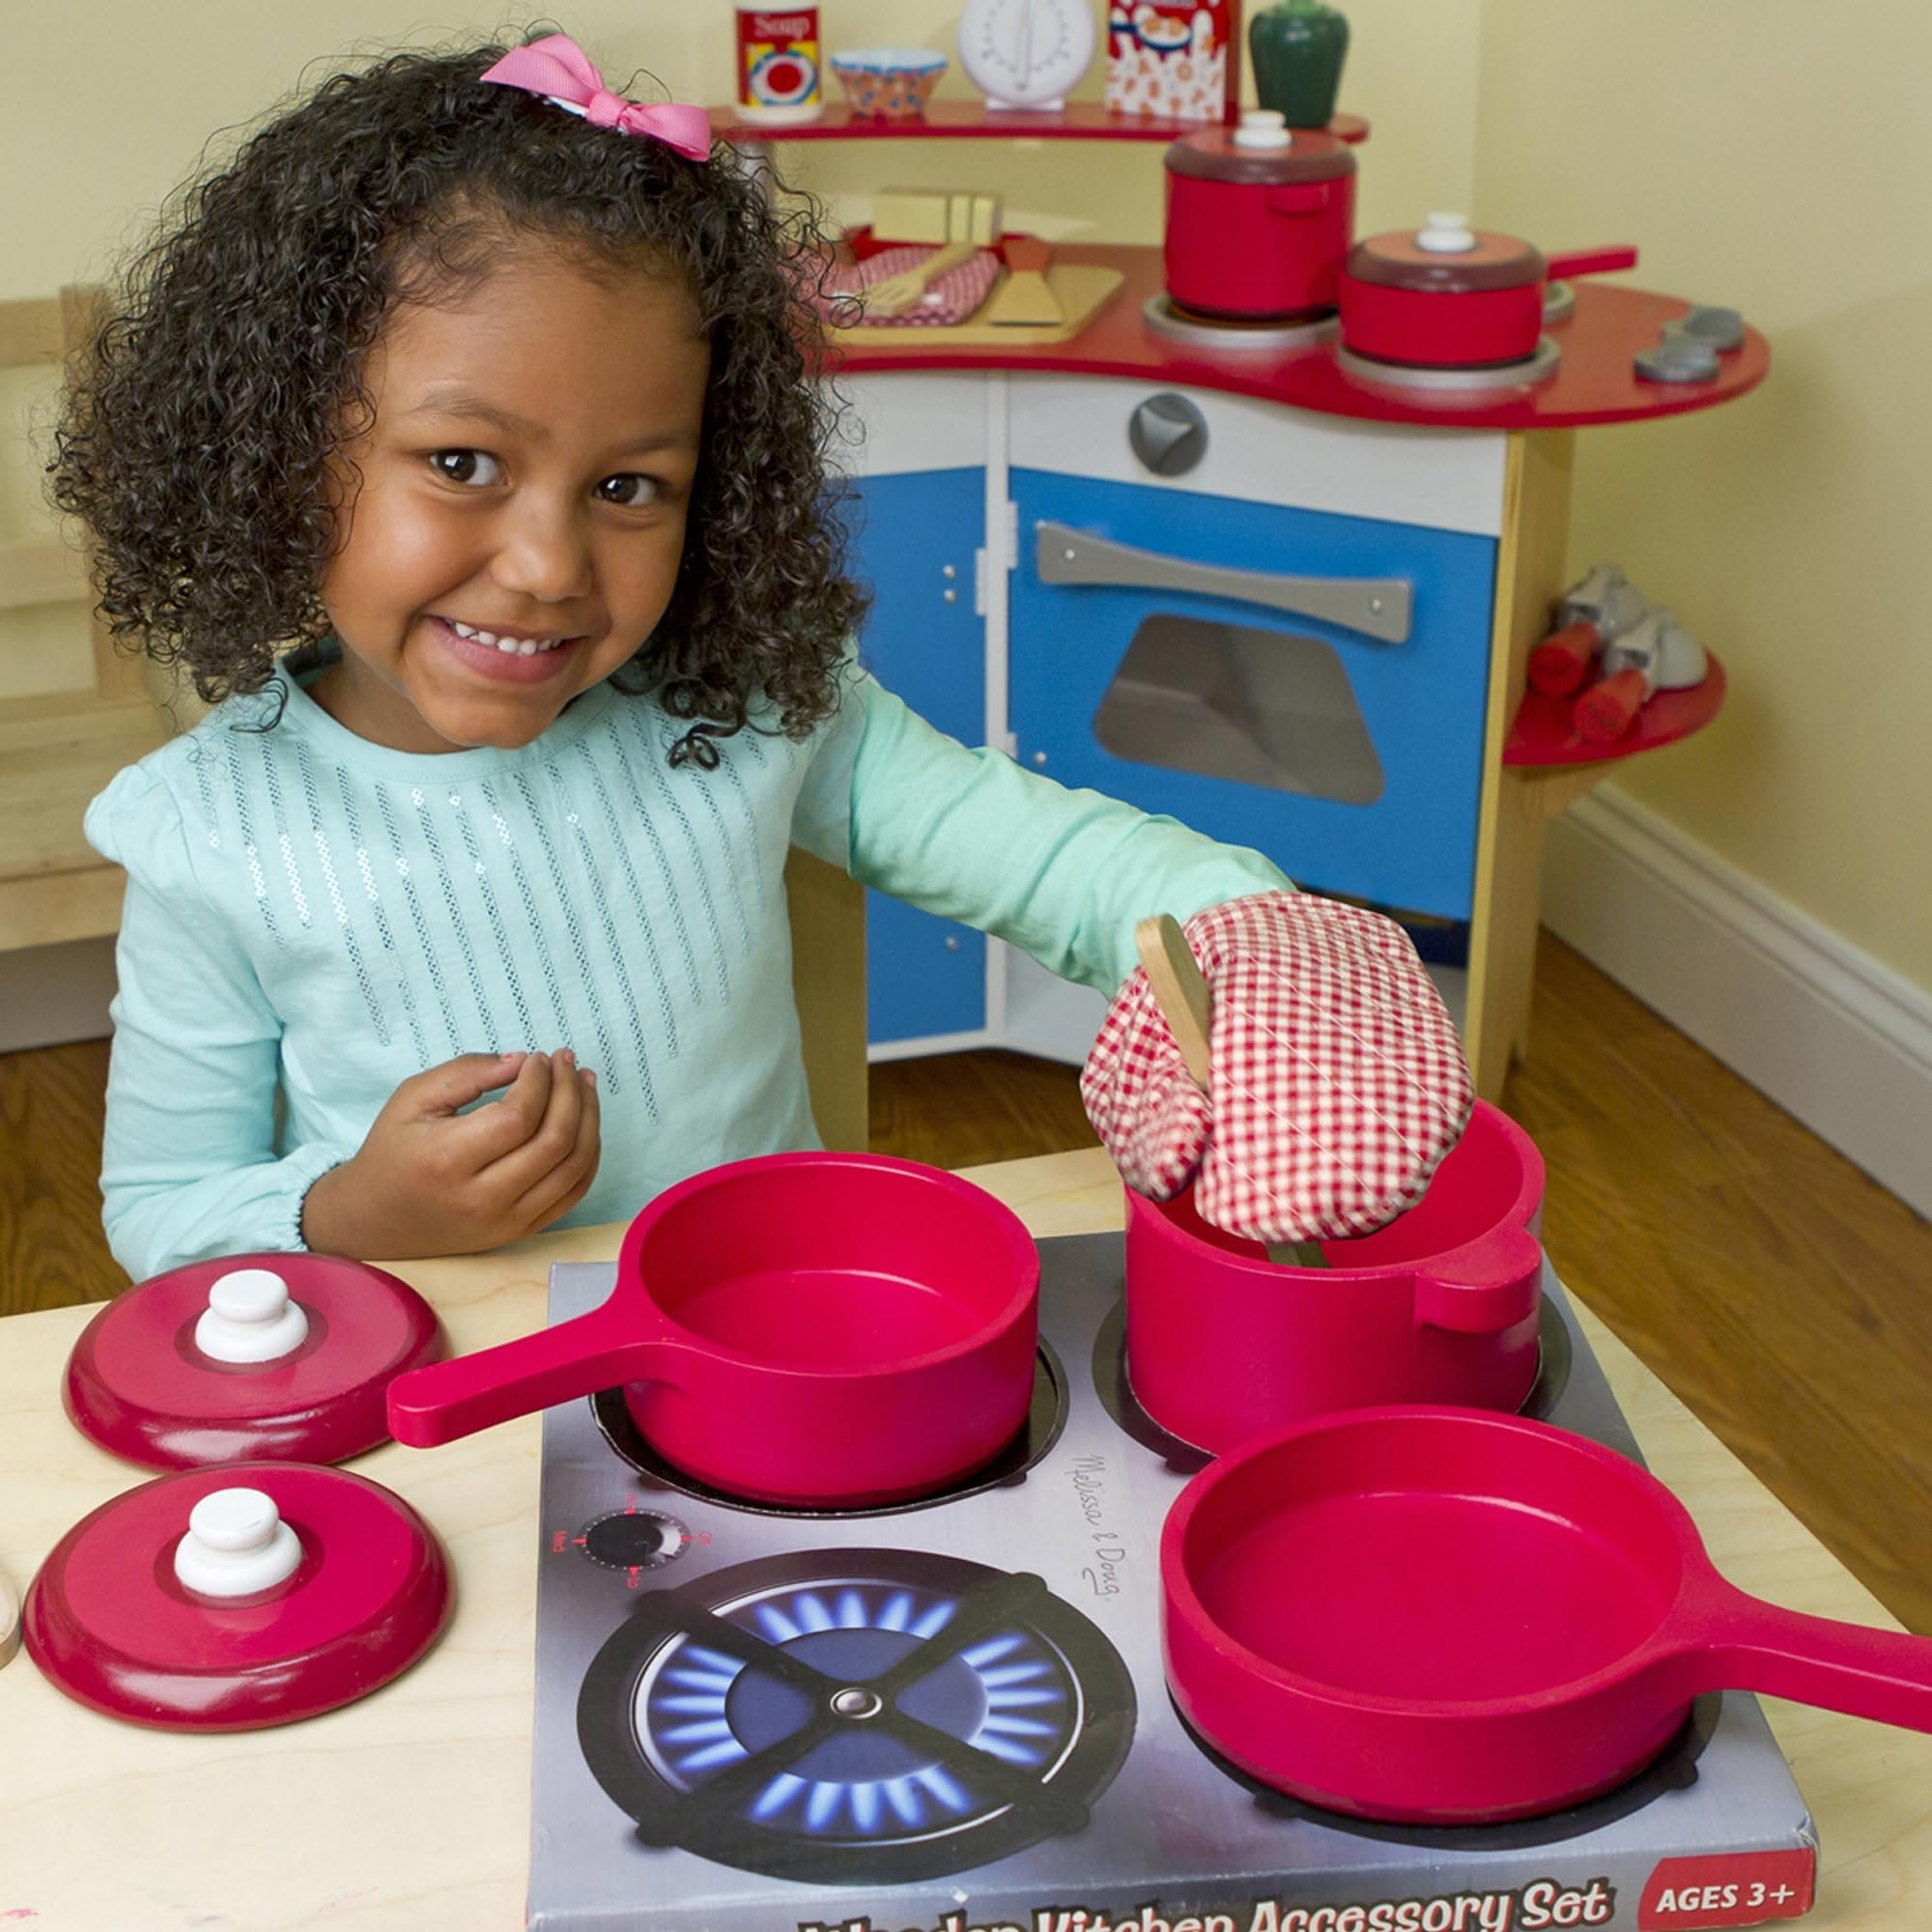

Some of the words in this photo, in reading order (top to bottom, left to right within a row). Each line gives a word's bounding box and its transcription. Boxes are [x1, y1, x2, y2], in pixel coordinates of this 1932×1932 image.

[753, 14, 810, 41] Soup
[1065, 1453, 1106, 1526] Melissa
[1082, 1548, 1126, 1596] Doug
[1248, 1893, 1516, 1932] Accessory
[1520, 1880, 1612, 1928] Set
[1655, 1884, 1739, 1913] AGES
[1746, 1882, 1795, 1908] 3+
